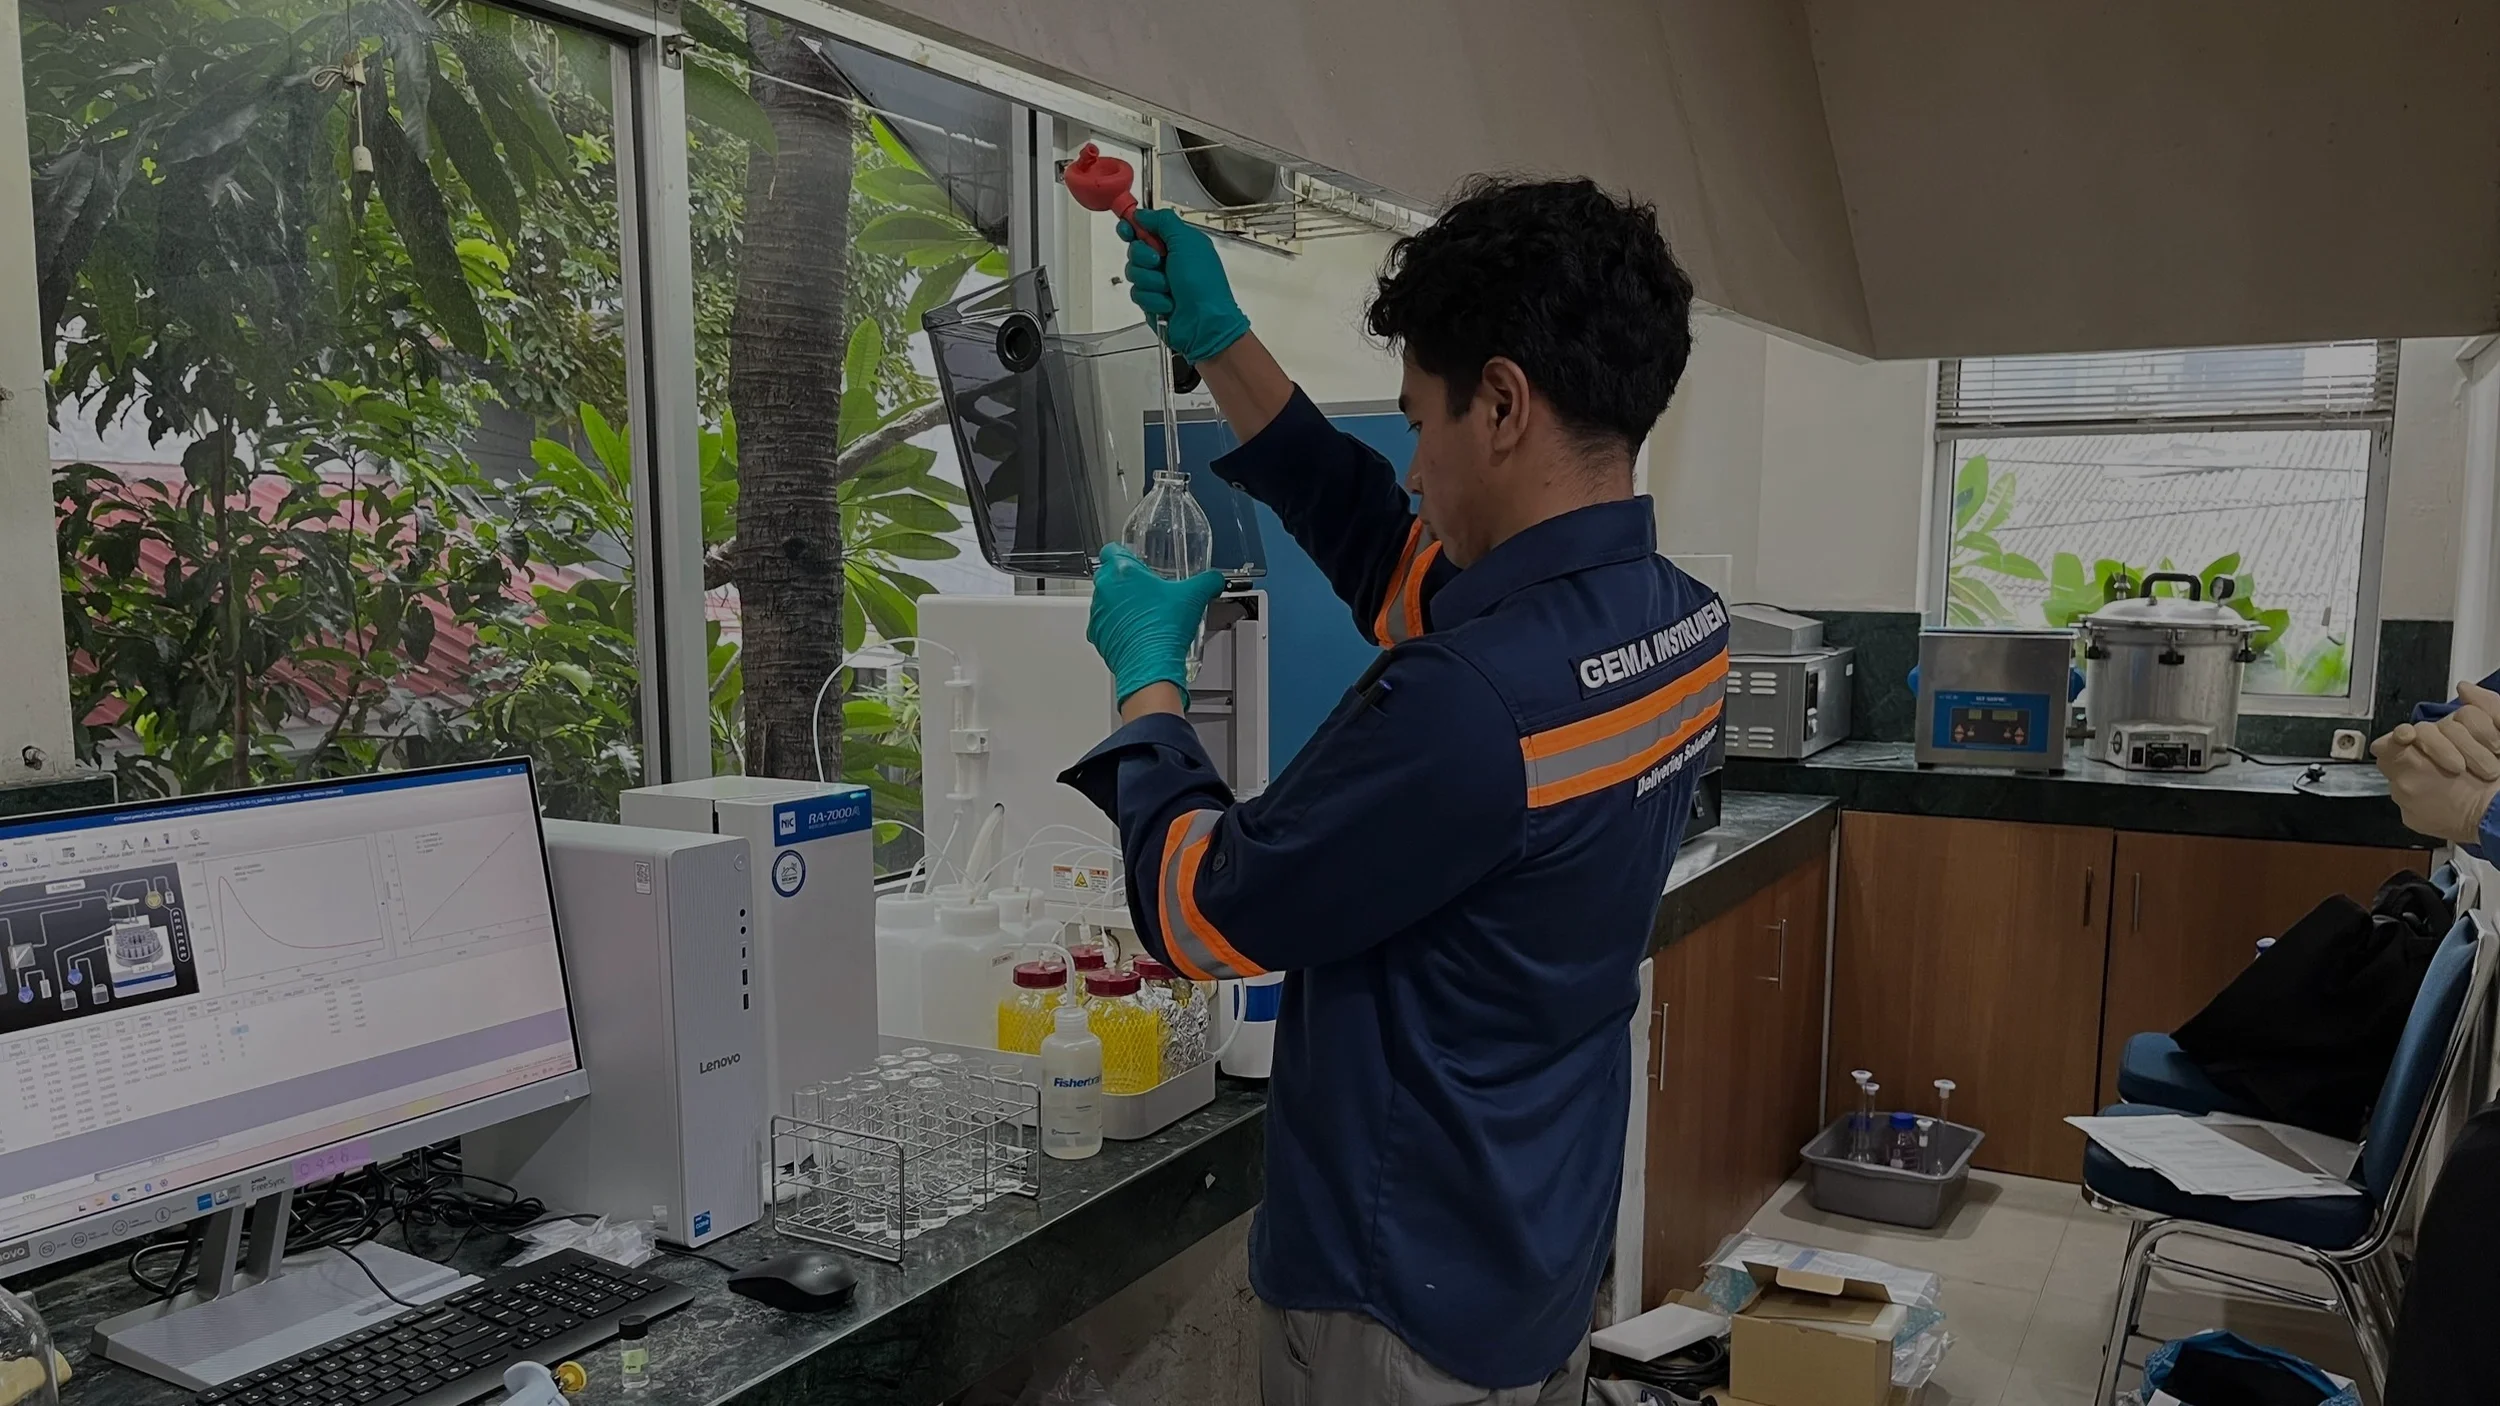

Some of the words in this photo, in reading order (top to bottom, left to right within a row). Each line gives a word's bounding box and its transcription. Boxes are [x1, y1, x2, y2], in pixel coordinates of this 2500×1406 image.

[1579, 640, 1654, 689] GEMA
[1636, 752, 1684, 798] Delivering
[781, 817, 794, 829] NIC
[808, 805, 861, 825] RA-7000A
[699, 1053, 741, 1075] Lenovo
[251, 1177, 287, 1193] FreeSync
[0, 1247, 26, 1261] ovo
